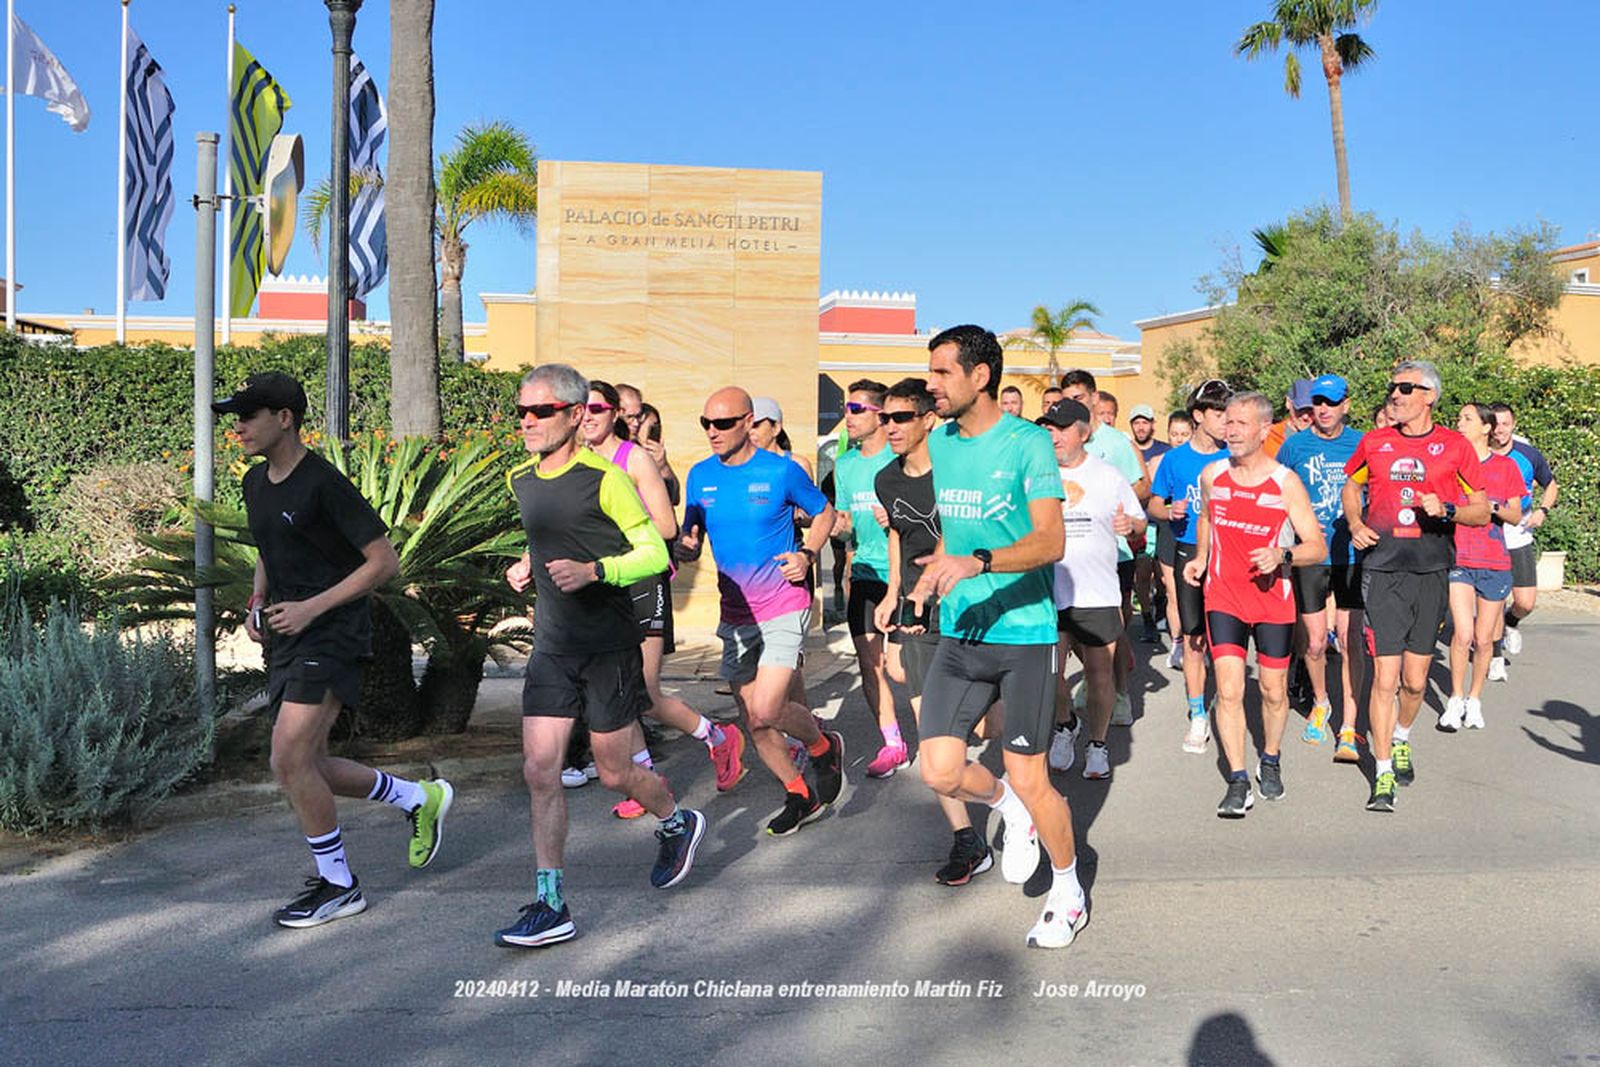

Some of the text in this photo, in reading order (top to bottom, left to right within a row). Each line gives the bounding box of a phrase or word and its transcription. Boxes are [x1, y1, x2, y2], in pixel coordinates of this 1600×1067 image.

[565, 208, 799, 231] PALACIO de SANCTI PETRI
[586, 234, 596, 244] A
[607, 234, 655, 247] GRAN
[727, 239, 779, 251] HOTEL
[939, 488, 983, 503] MEDIA
